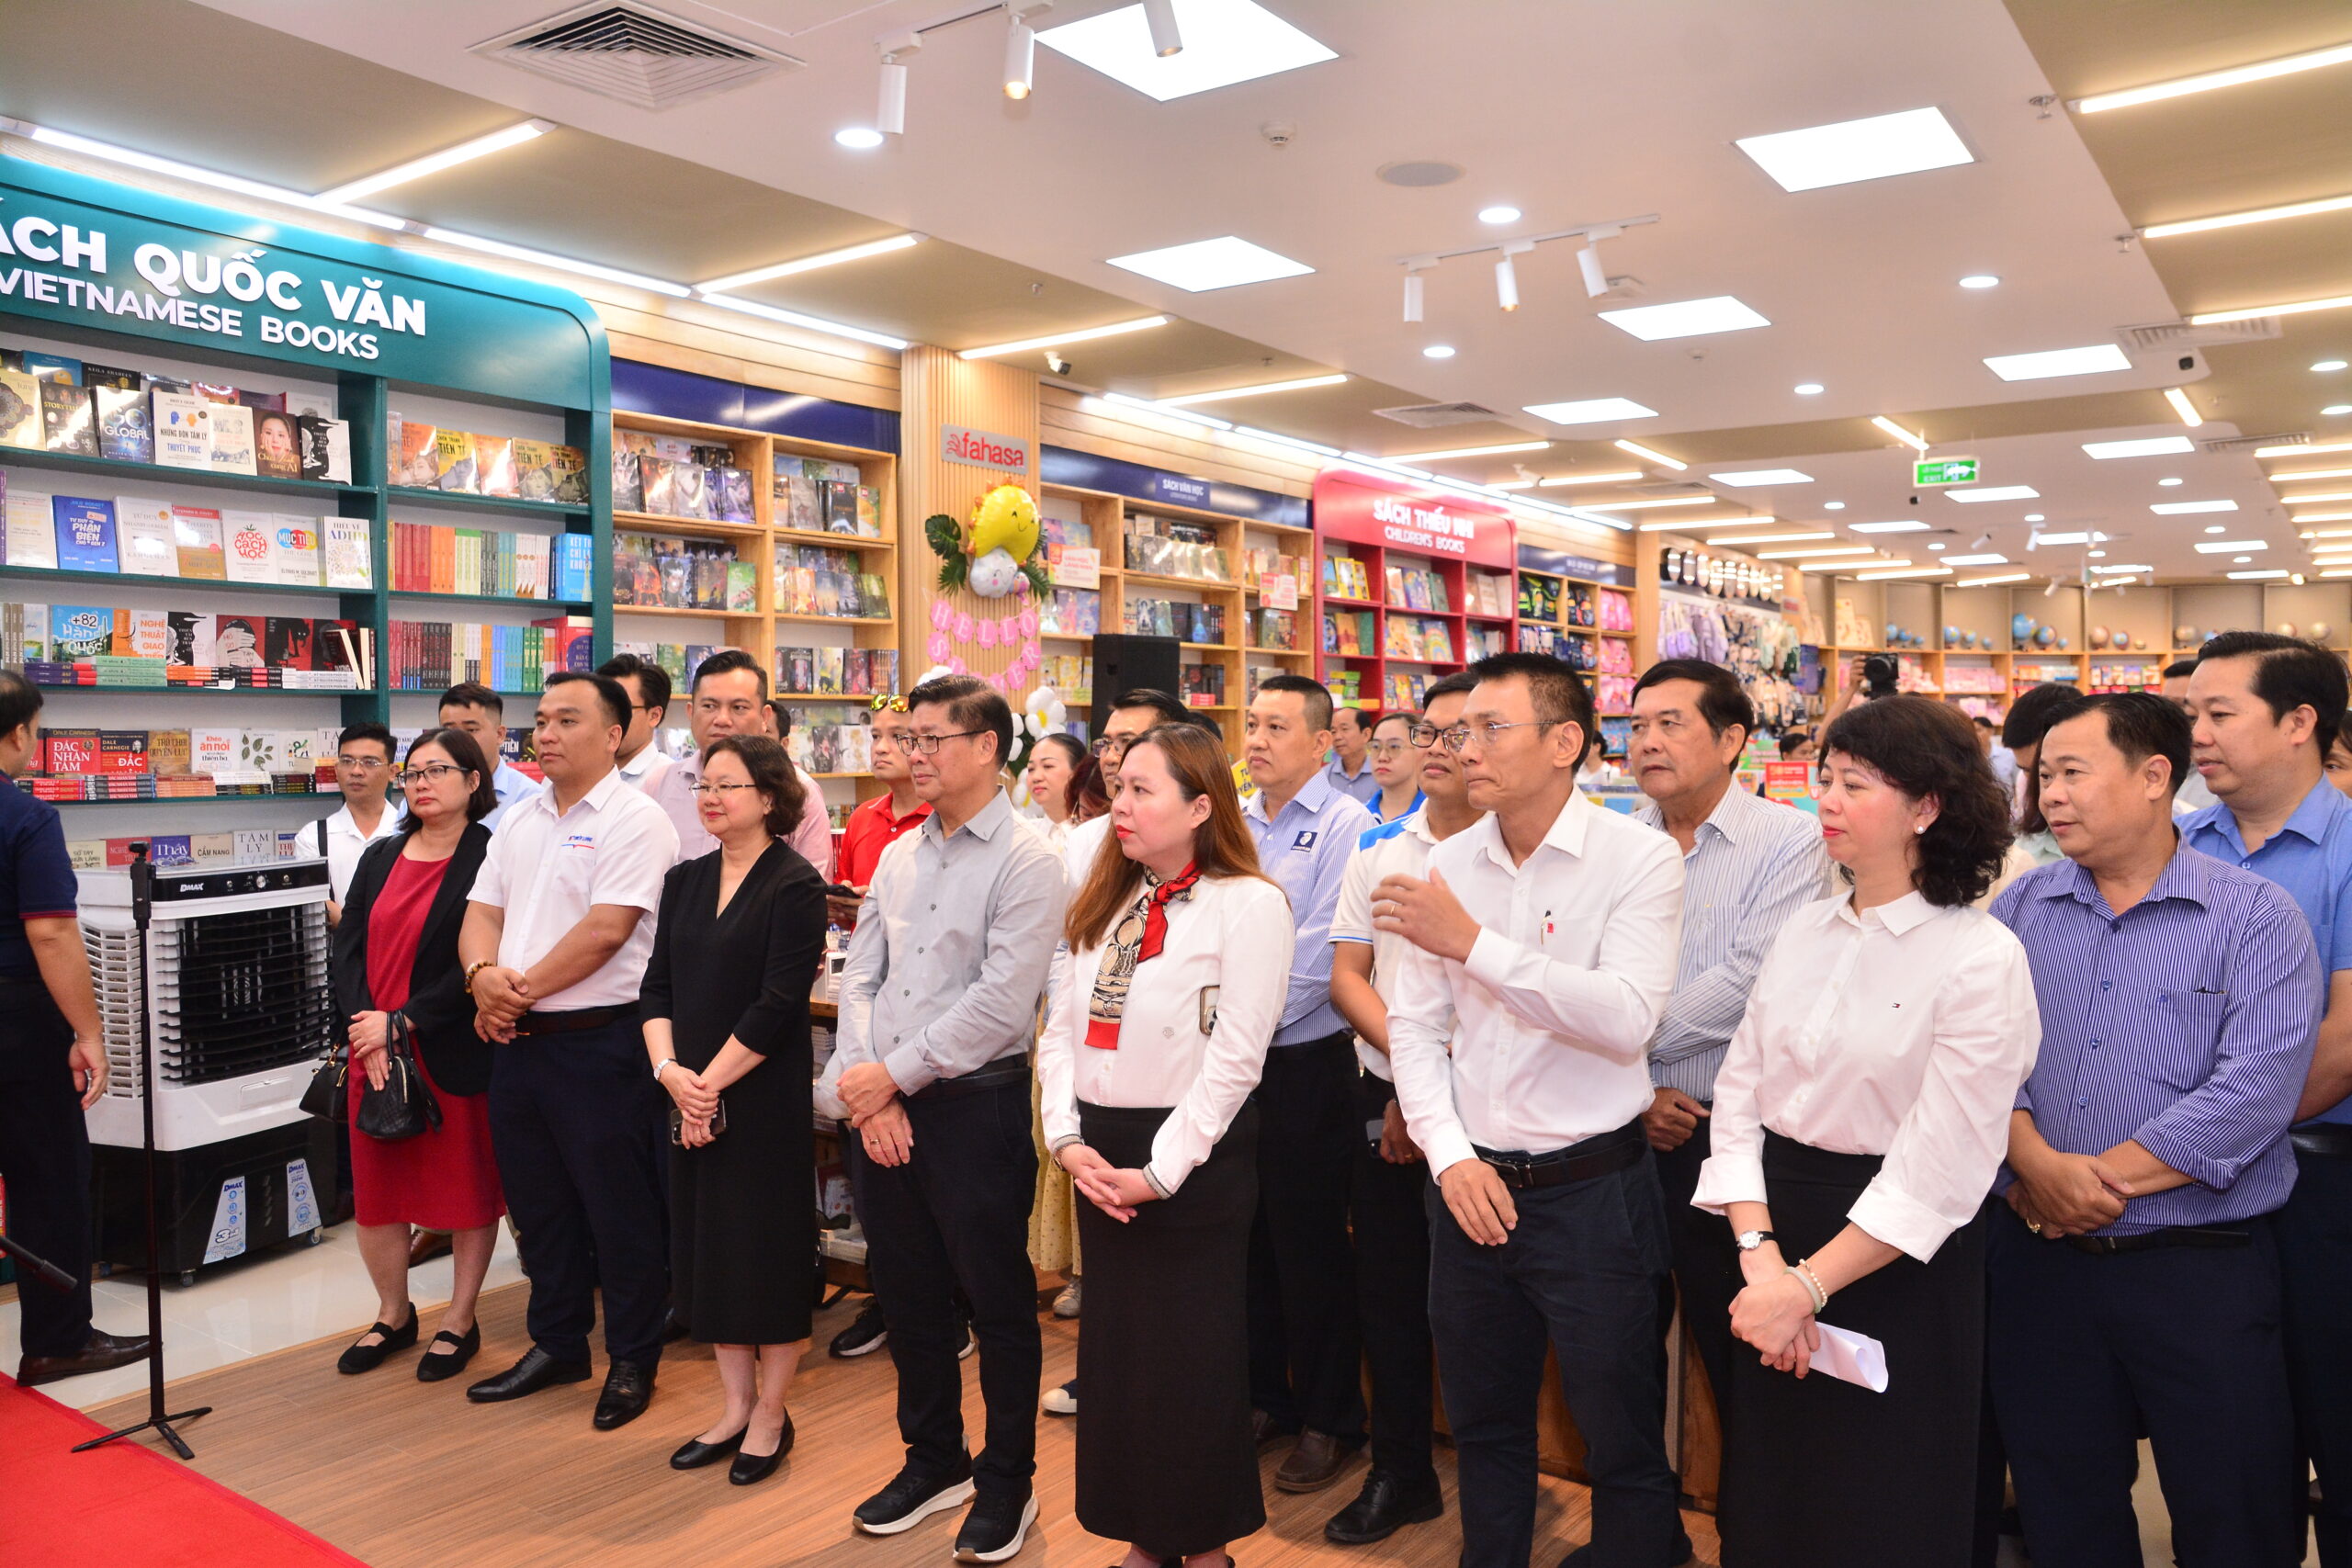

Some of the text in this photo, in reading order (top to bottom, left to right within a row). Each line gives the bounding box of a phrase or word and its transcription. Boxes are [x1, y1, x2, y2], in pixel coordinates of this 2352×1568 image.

[134, 249, 302, 310] QUỐC
[321, 276, 425, 336] VĂN
[0, 268, 379, 359] VIETNAMESE BOOKS
[104, 425, 151, 440] GLOBAL
[962, 432, 1024, 468] fahasa
[1373, 498, 1475, 539] SÁCH THIẾU NHI
[1435, 536, 1465, 554] BOOKS
[73, 614, 97, 627] +82
[141, 618, 165, 630] NGHỆ
[933, 603, 1035, 643] HELLO
[141, 630, 165, 641] THUẬT
[53, 750, 90, 761] NHÂN
[118, 752, 143, 767] ĐẮC
[53, 761, 81, 772] TÂM
[180, 883, 205, 893] DMAX
[287, 1162, 305, 1174] DMAX
[223, 1181, 243, 1192] DMAX
